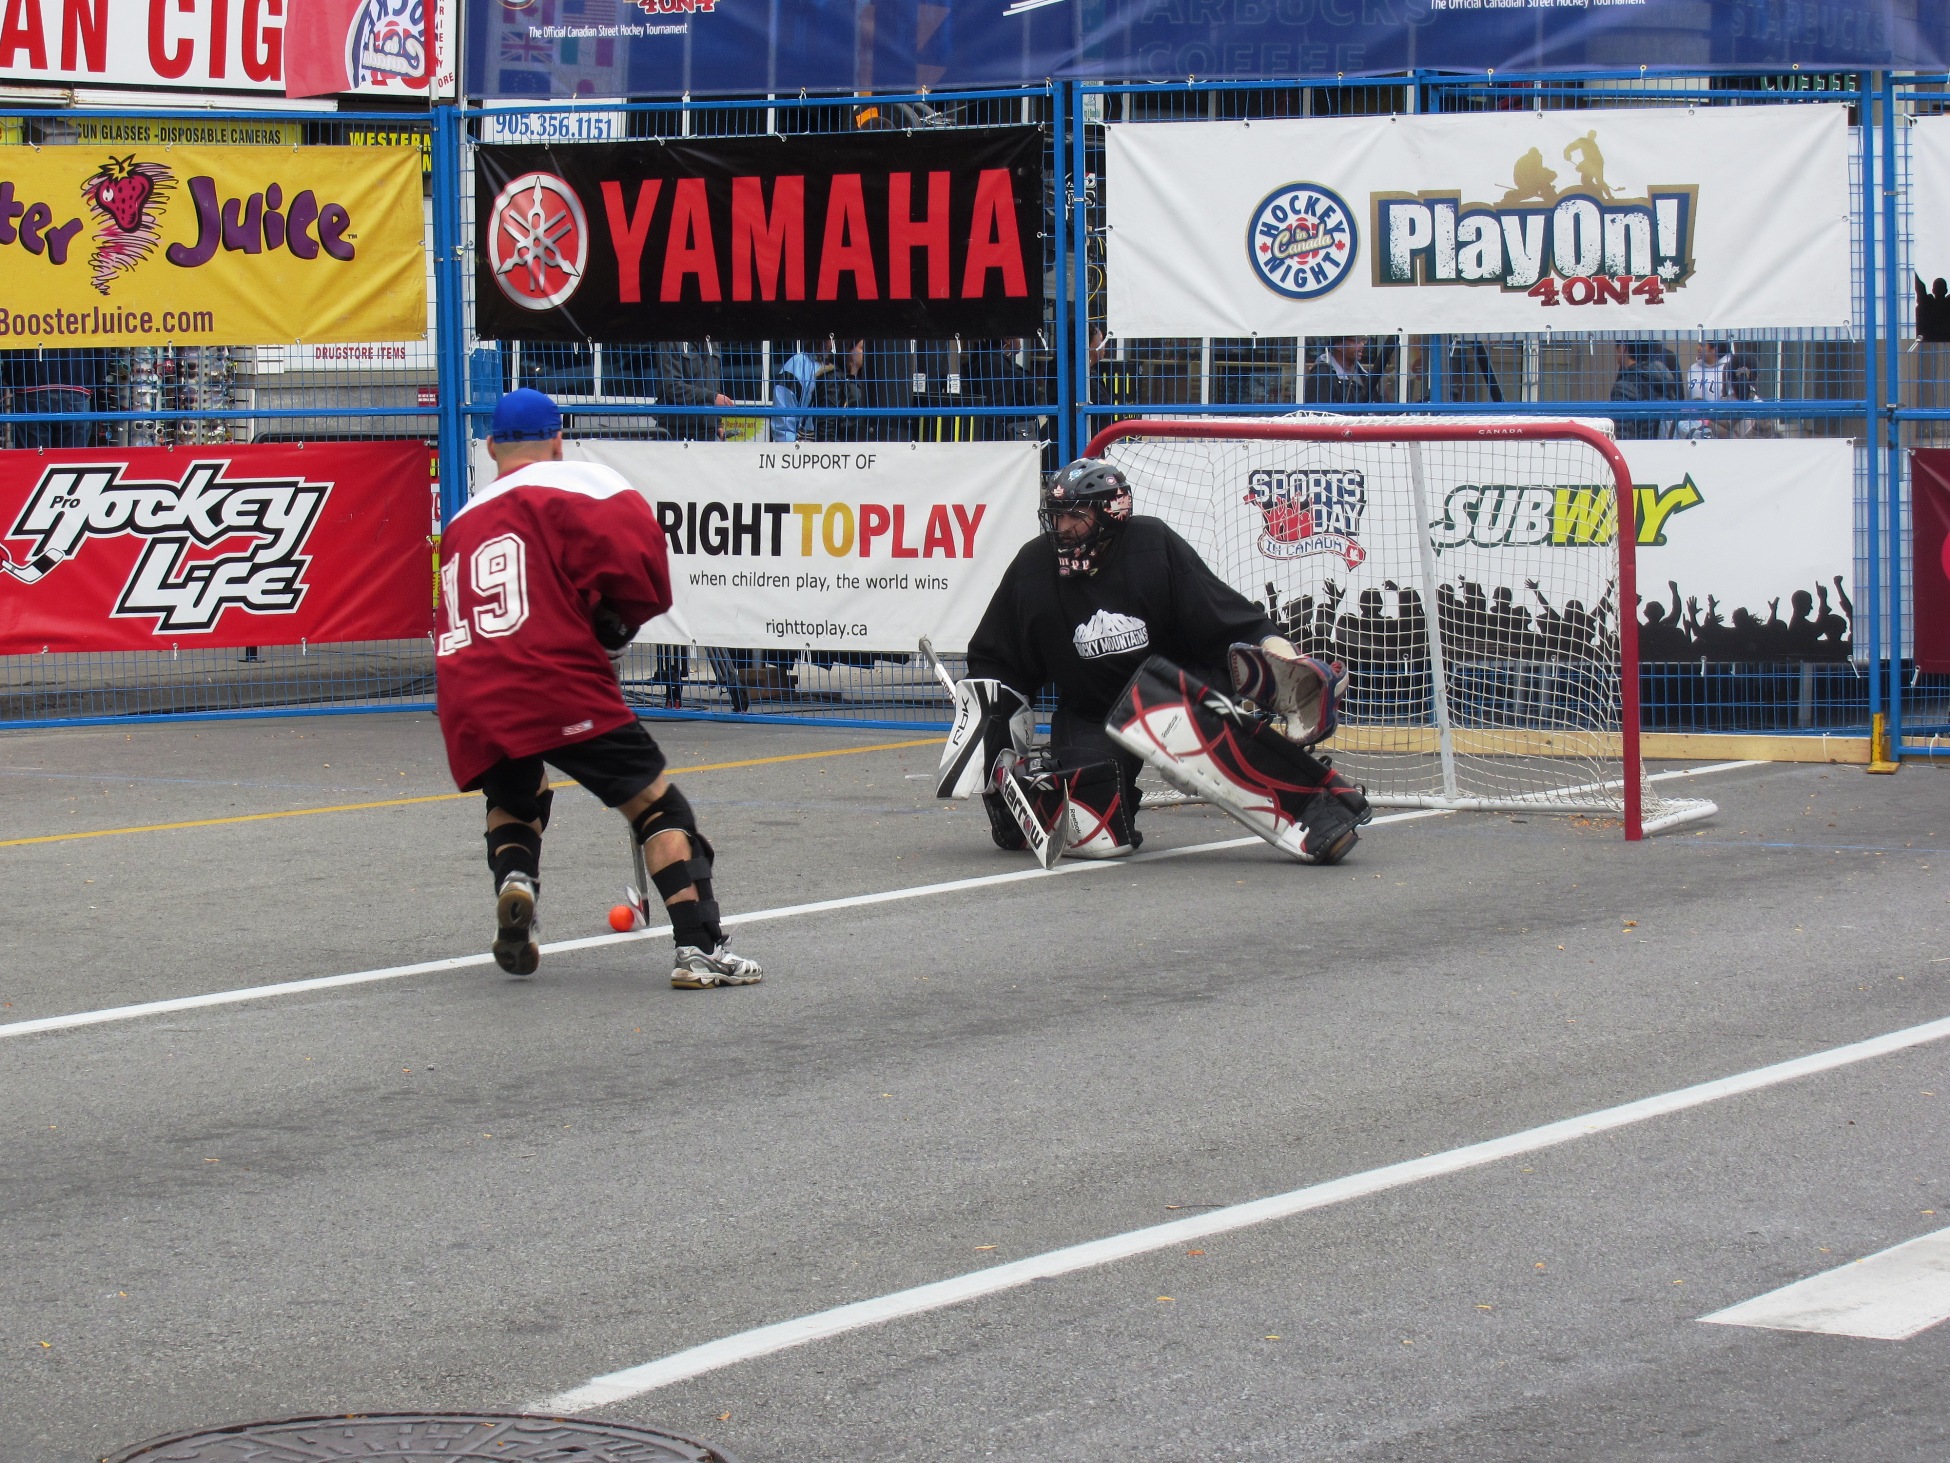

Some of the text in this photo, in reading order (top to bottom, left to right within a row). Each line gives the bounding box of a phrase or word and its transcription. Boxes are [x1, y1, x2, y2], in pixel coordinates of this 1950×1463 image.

[529, 23, 688, 38] The Official Canadian Street Hockey Tournament
[76, 123, 98, 140] SUN
[101, 125, 150, 141] GLASSES
[230, 129, 281, 144] CAMERAS
[496, 113, 612, 139] 905.356.1151
[166, 176, 355, 267] Juice
[1259, 195, 1346, 238] HOCKEY
[600, 169, 1028, 303] YAMAHA
[1272, 224, 1334, 258] Canada
[1296, 229, 1308, 240] in
[1264, 251, 1341, 288] NIGHT
[1527, 275, 1665, 306] 4ON4
[0, 307, 214, 335] BoosterJuice.com
[316, 347, 406, 359] DRUGSTORE ITEMS
[759, 454, 876, 470] IN SUPPORT OF
[1251, 472, 1362, 503] SPORTS
[50, 495, 81, 509] Pro
[1312, 504, 1361, 534] DAY
[1285, 536, 1343, 556] CANADA
[437, 532, 530, 656] 19
[689, 571, 949, 591] when children play, the world wins
[765, 619, 868, 638] righttoplay.ca
[1075, 639, 1099, 657] CKY
